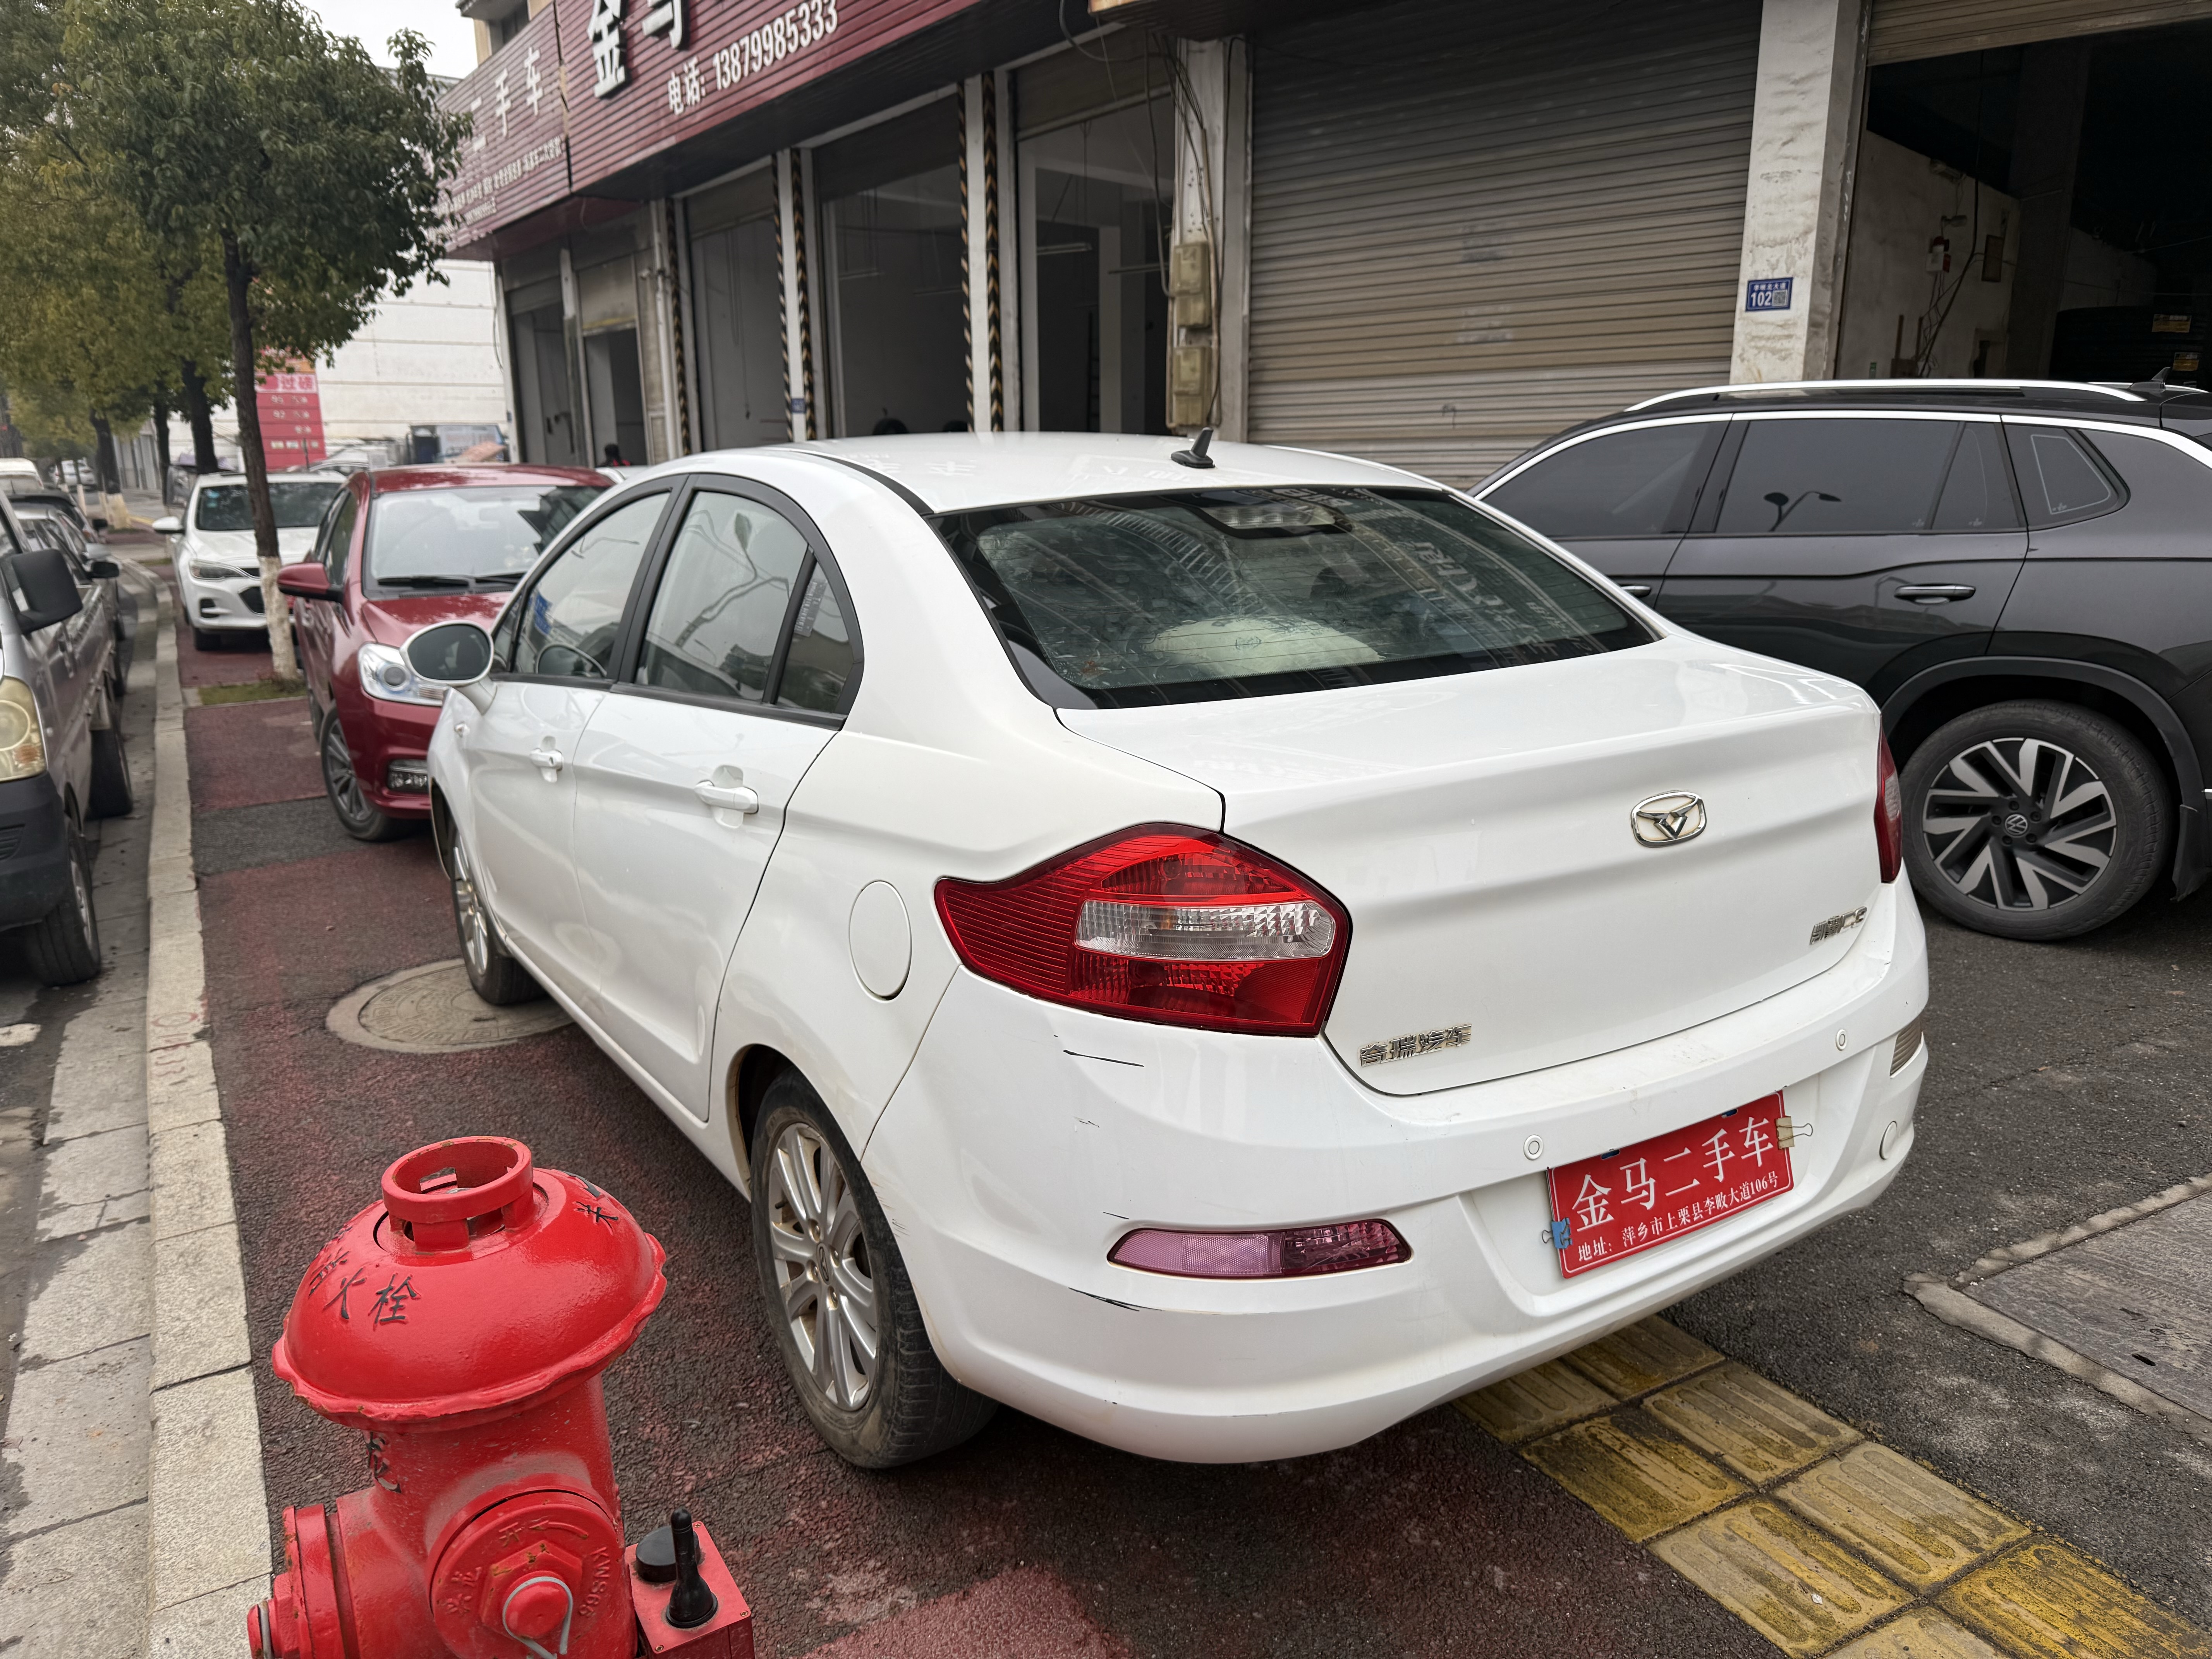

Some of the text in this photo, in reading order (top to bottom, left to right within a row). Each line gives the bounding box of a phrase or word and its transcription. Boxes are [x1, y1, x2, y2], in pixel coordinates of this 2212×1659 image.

[1751, 291, 1772, 307] 102
[1571, 1116, 1774, 1233] 金马二手车
